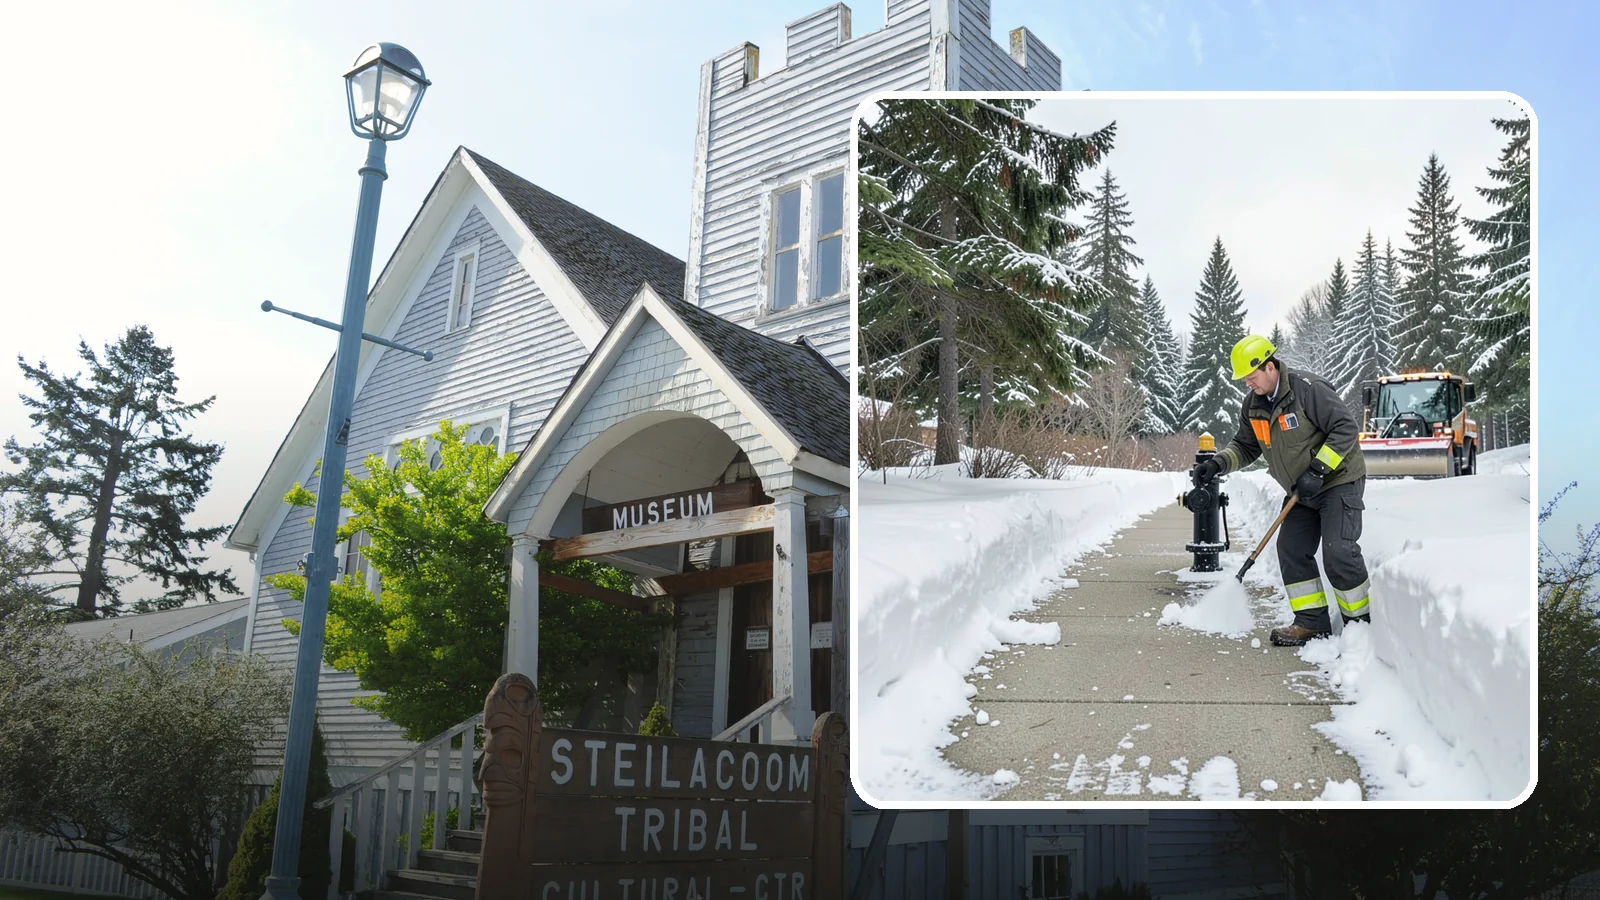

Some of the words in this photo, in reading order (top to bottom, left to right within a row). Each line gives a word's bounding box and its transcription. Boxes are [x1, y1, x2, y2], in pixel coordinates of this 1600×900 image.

[612, 491, 714, 531] MUSEUM
[550, 738, 809, 793] STEILACOOM
[614, 806, 757, 852] TRIBAL
